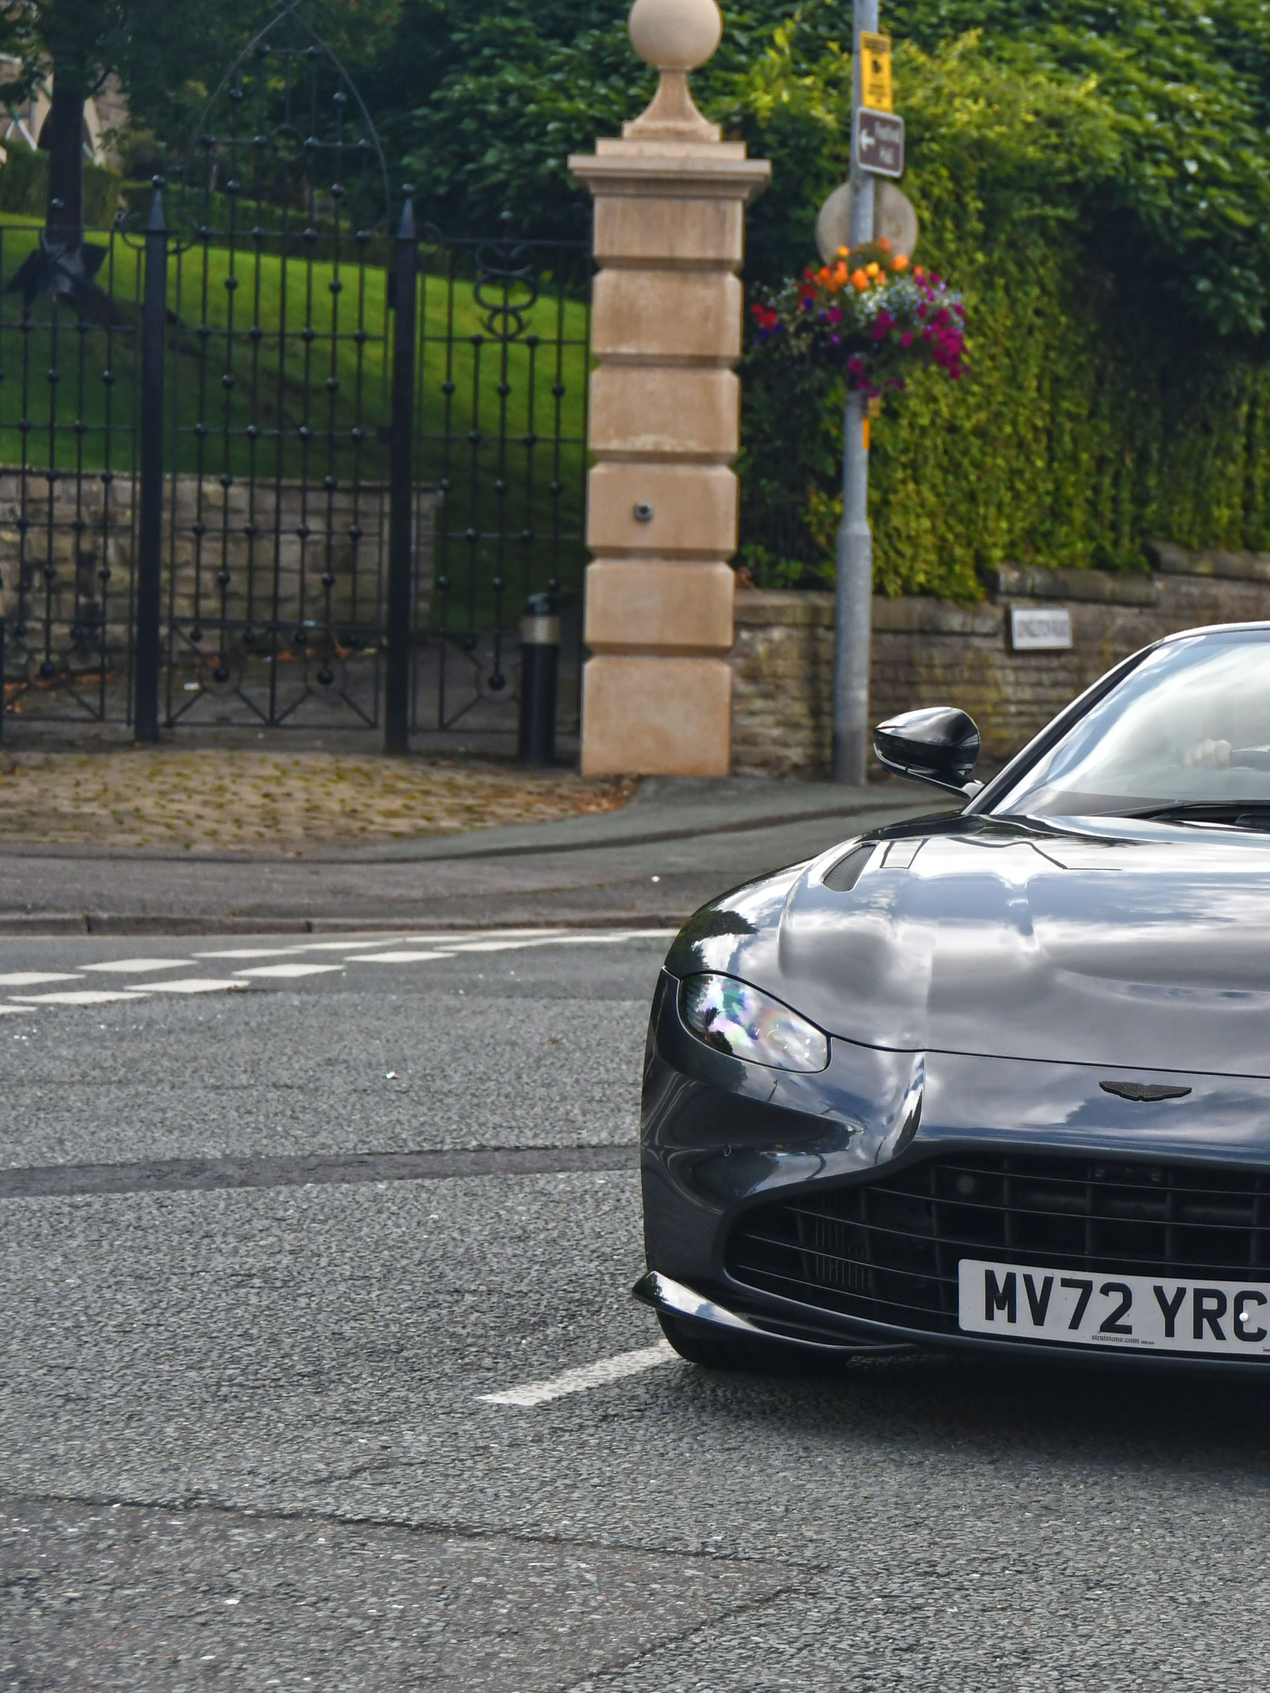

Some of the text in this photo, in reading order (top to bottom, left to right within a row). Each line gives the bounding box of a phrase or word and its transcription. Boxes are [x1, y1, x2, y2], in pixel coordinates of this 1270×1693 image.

[984, 1269, 1268, 1343] MV72 YRC
[1091, 1334, 1140, 1344] stratstone.com
